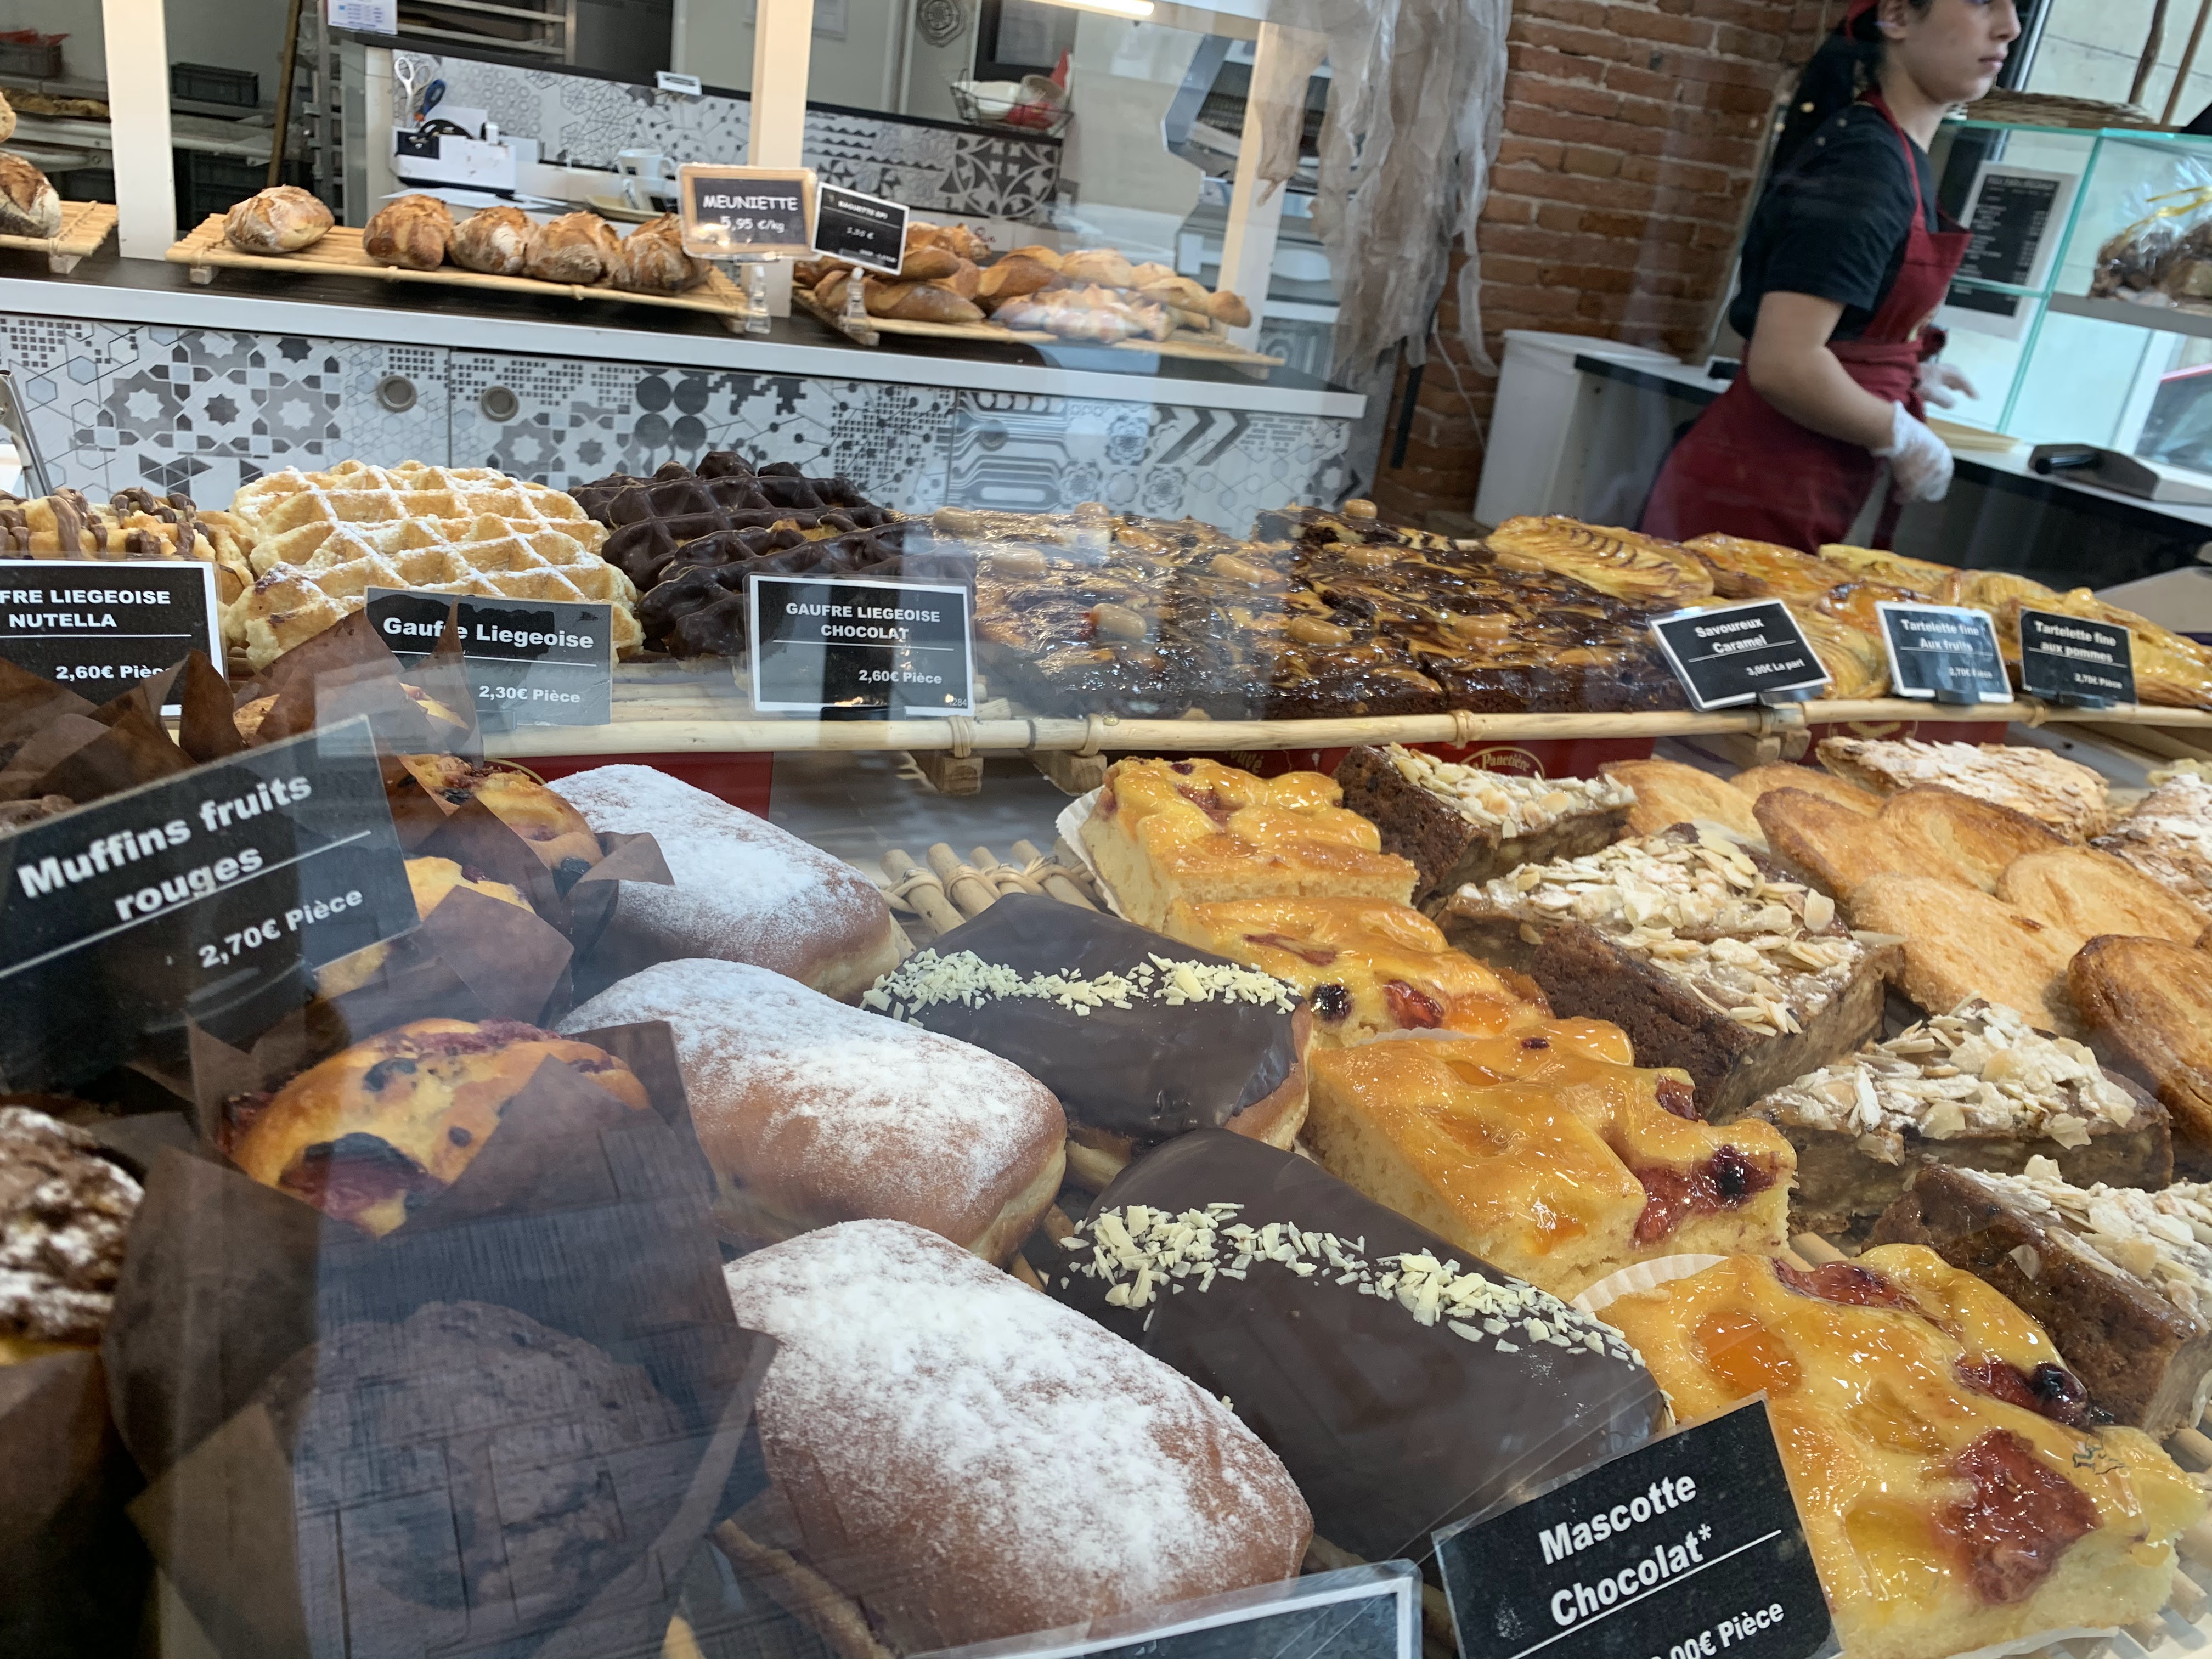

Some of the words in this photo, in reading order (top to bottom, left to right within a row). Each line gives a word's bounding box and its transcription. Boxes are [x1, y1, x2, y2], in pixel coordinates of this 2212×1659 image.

[703, 194, 798, 211] MEUNIETTE
[720, 216, 754, 231] 5,95
[757, 219, 785, 233] €/kg
[50, 590, 171, 604] LIEGEOISE
[9, 613, 117, 628] NUTELLA
[786, 602, 853, 618] GAUFRE
[857, 606, 940, 623] LIEGEOISE
[383, 617, 468, 640] Gaufe
[476, 624, 594, 649] Liegeoise
[821, 624, 909, 640] CHOCOLAT
[1695, 618, 1765, 638] Savoureux
[1900, 618, 1957, 635] Tartelette
[1958, 625, 1980, 636] fine
[2033, 620, 2092, 642] Tartelette
[2093, 631, 2117, 647] fine
[1712, 634, 1769, 654] Caramel
[1919, 637, 1942, 650] Aux
[1943, 641, 1974, 652] fruits
[2040, 641, 2063, 654] aux
[2064, 646, 2114, 663] pommes
[55, 665, 115, 682] 2,60€
[119, 665, 172, 679] Pièc
[859, 670, 899, 684] 2,60€
[902, 672, 943, 684] Pièce
[1745, 664, 1772, 677] 3,00€
[1773, 662, 1786, 671] La
[479, 685, 528, 701] 2,30€
[532, 688, 581, 703] Pièce
[16, 818, 192, 898] Muffins
[199, 775, 313, 831] fruits
[114, 848, 264, 922] rouges
[198, 918, 282, 969] 2,70€
[284, 890, 364, 932] Pièce
[1538, 1476, 1697, 1565] Mascotte
[1717, 1602, 1785, 1649] Pièce
